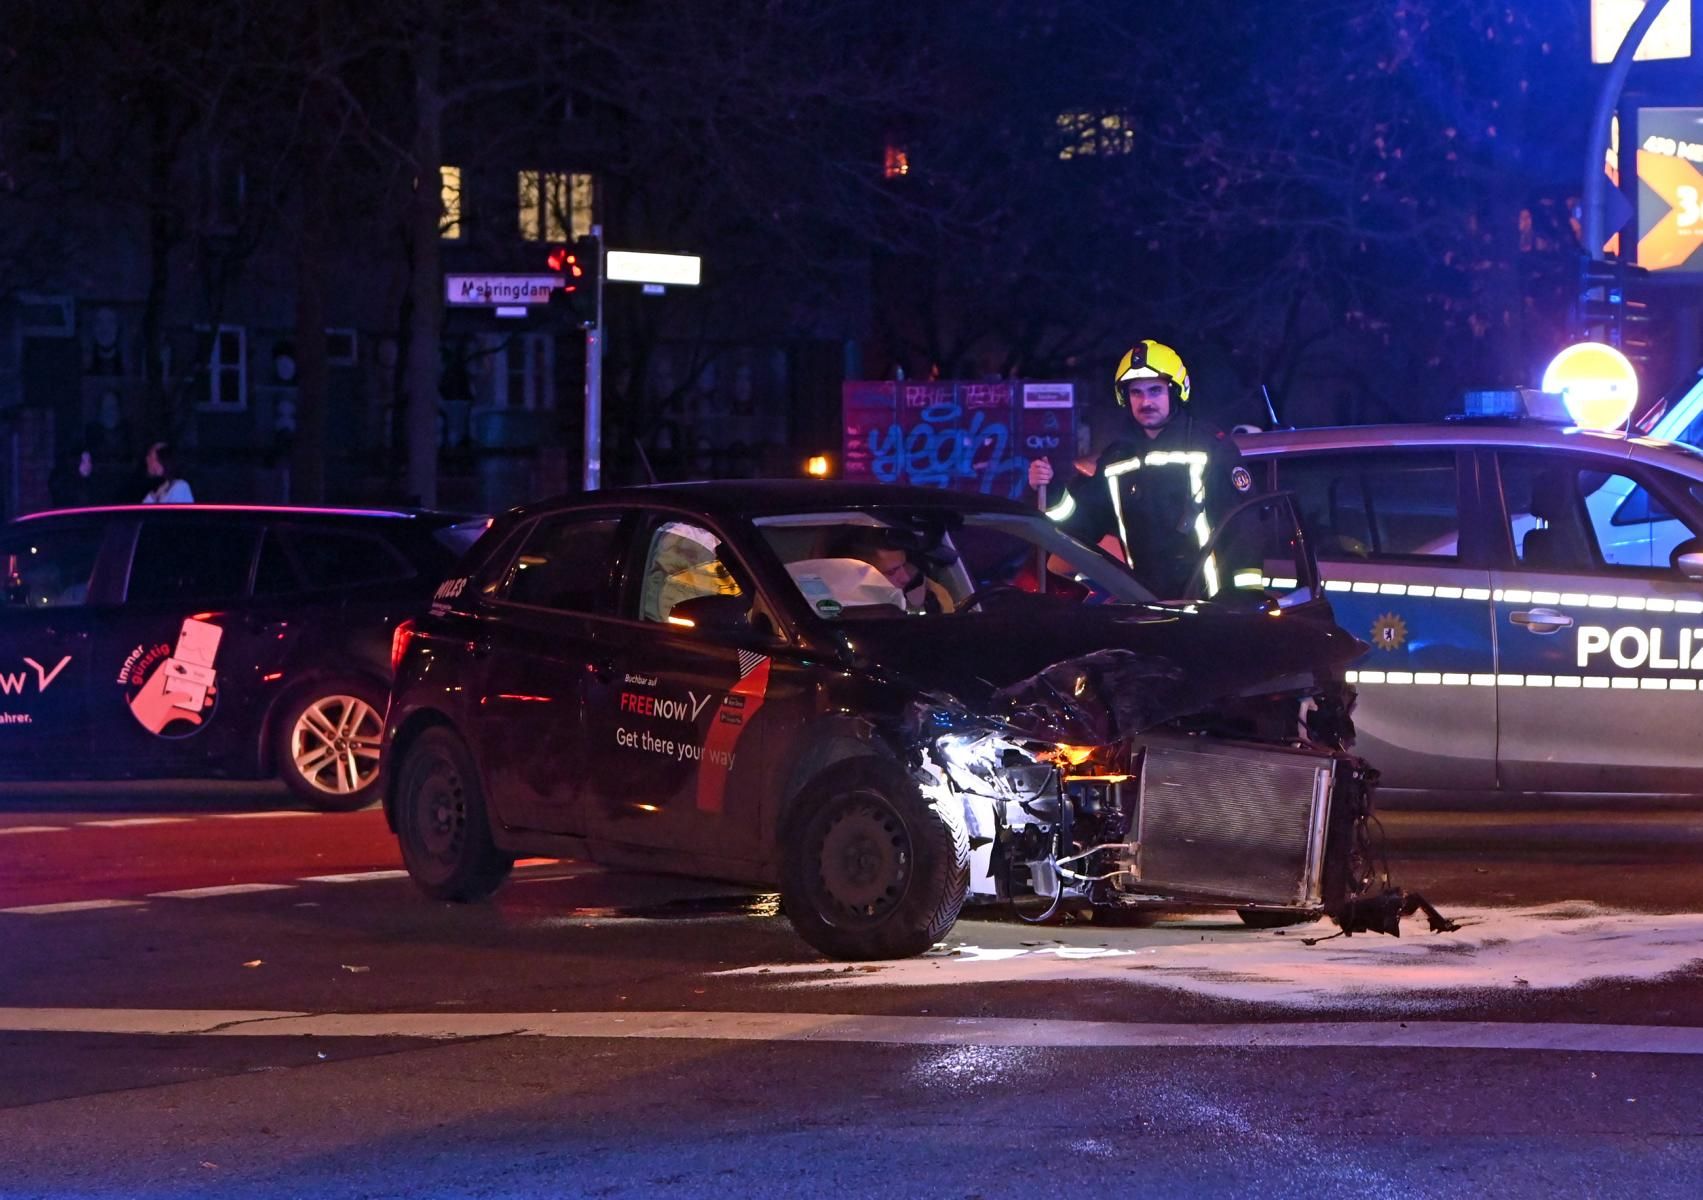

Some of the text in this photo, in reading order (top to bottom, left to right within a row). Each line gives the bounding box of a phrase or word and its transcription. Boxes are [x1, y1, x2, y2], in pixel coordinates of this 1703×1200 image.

[461, 280, 552, 300] Mehringdam
[116, 644, 144, 684] Immer
[131, 643, 170, 685] günstig
[624, 673, 658, 687] Buchbar auf
[0, 711, 32, 724] ahrer.
[616, 727, 736, 771] Get there your way
